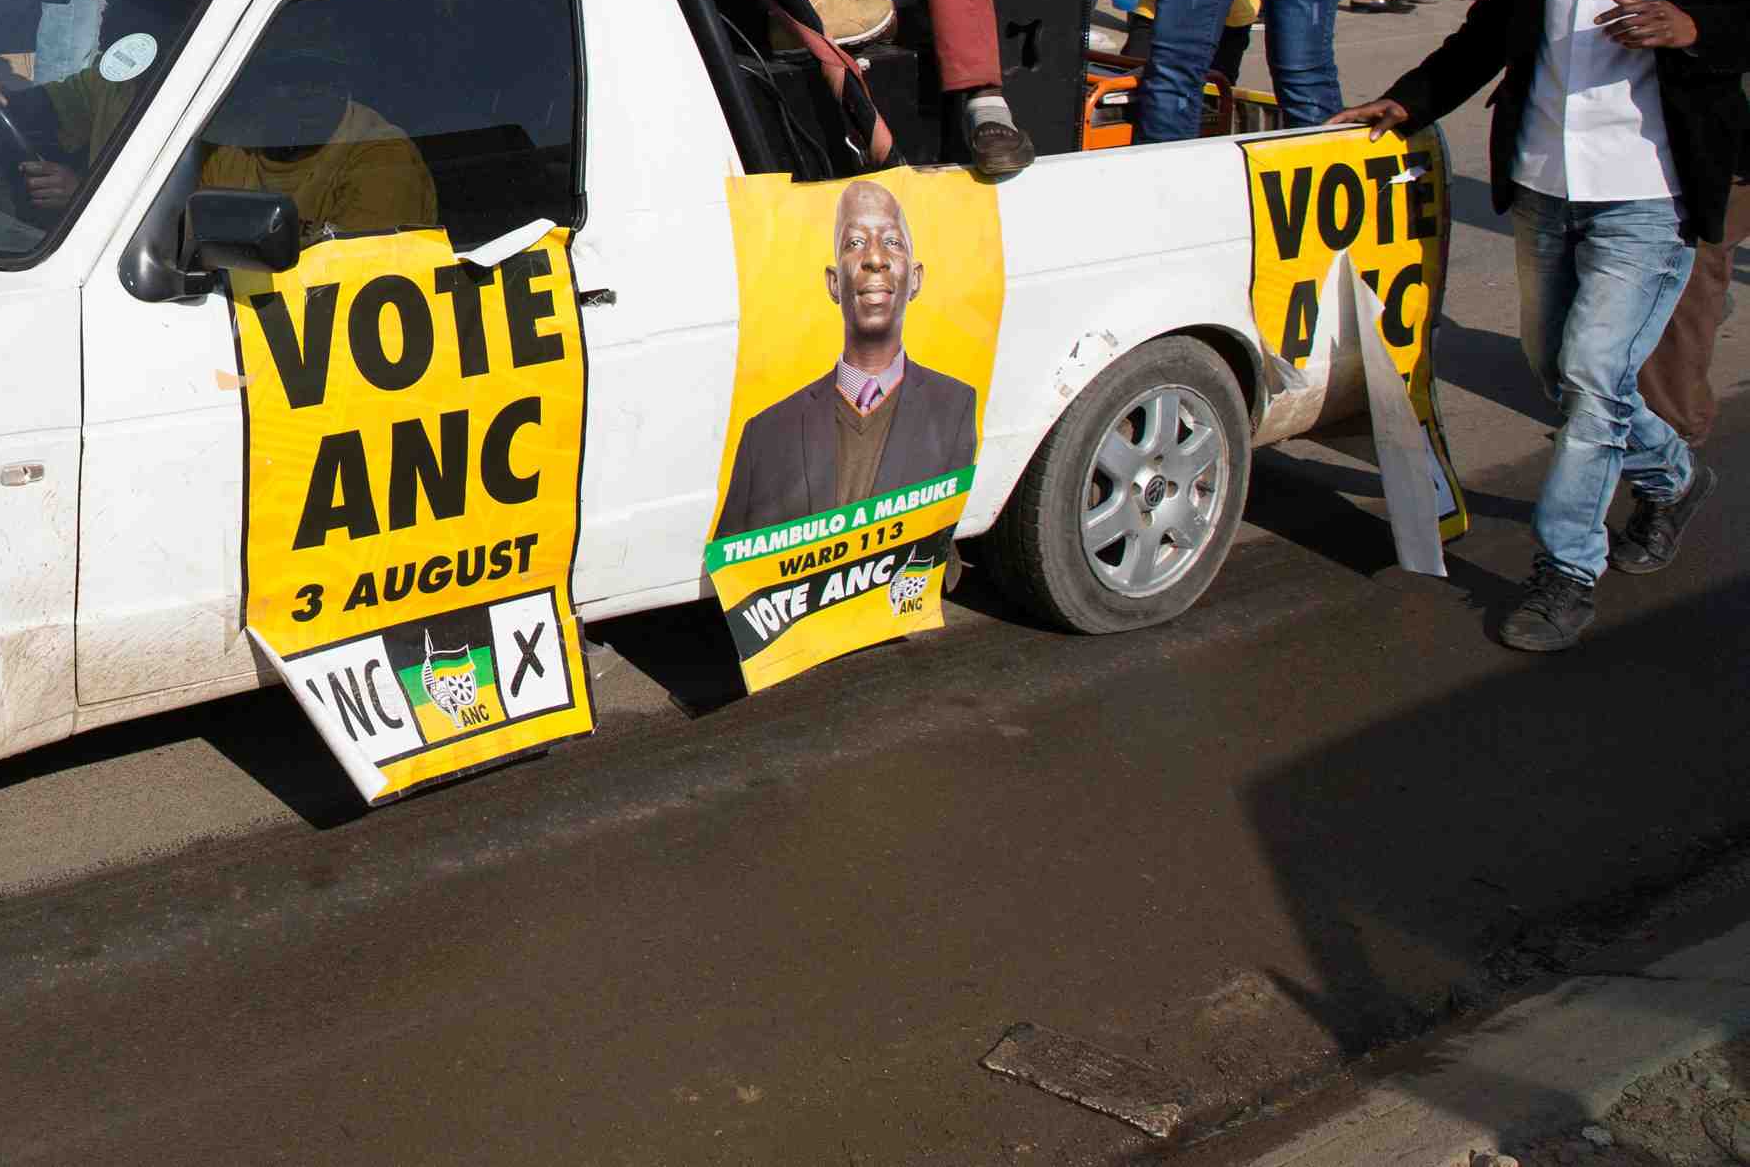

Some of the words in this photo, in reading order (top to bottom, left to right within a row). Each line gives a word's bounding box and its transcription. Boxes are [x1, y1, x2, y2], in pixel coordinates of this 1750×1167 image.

[1260, 151, 1438, 261] VOTE
[251, 248, 566, 411] VOTE
[1280, 263, 1425, 367] AC
[292, 396, 543, 551] ANC
[722, 513, 847, 563] THAMBULO
[852, 508, 868, 528] A
[873, 476, 959, 522] MABUKE
[777, 541, 849, 578] WARD
[860, 520, 905, 551] 113
[291, 583, 325, 623] 3
[343, 533, 540, 612] AUGUST
[741, 582, 811, 642] VOTE
[818, 554, 896, 608] ANC
[899, 597, 924, 615] ANC
[306, 658, 405, 743] NC
[460, 704, 490, 728] ANC
